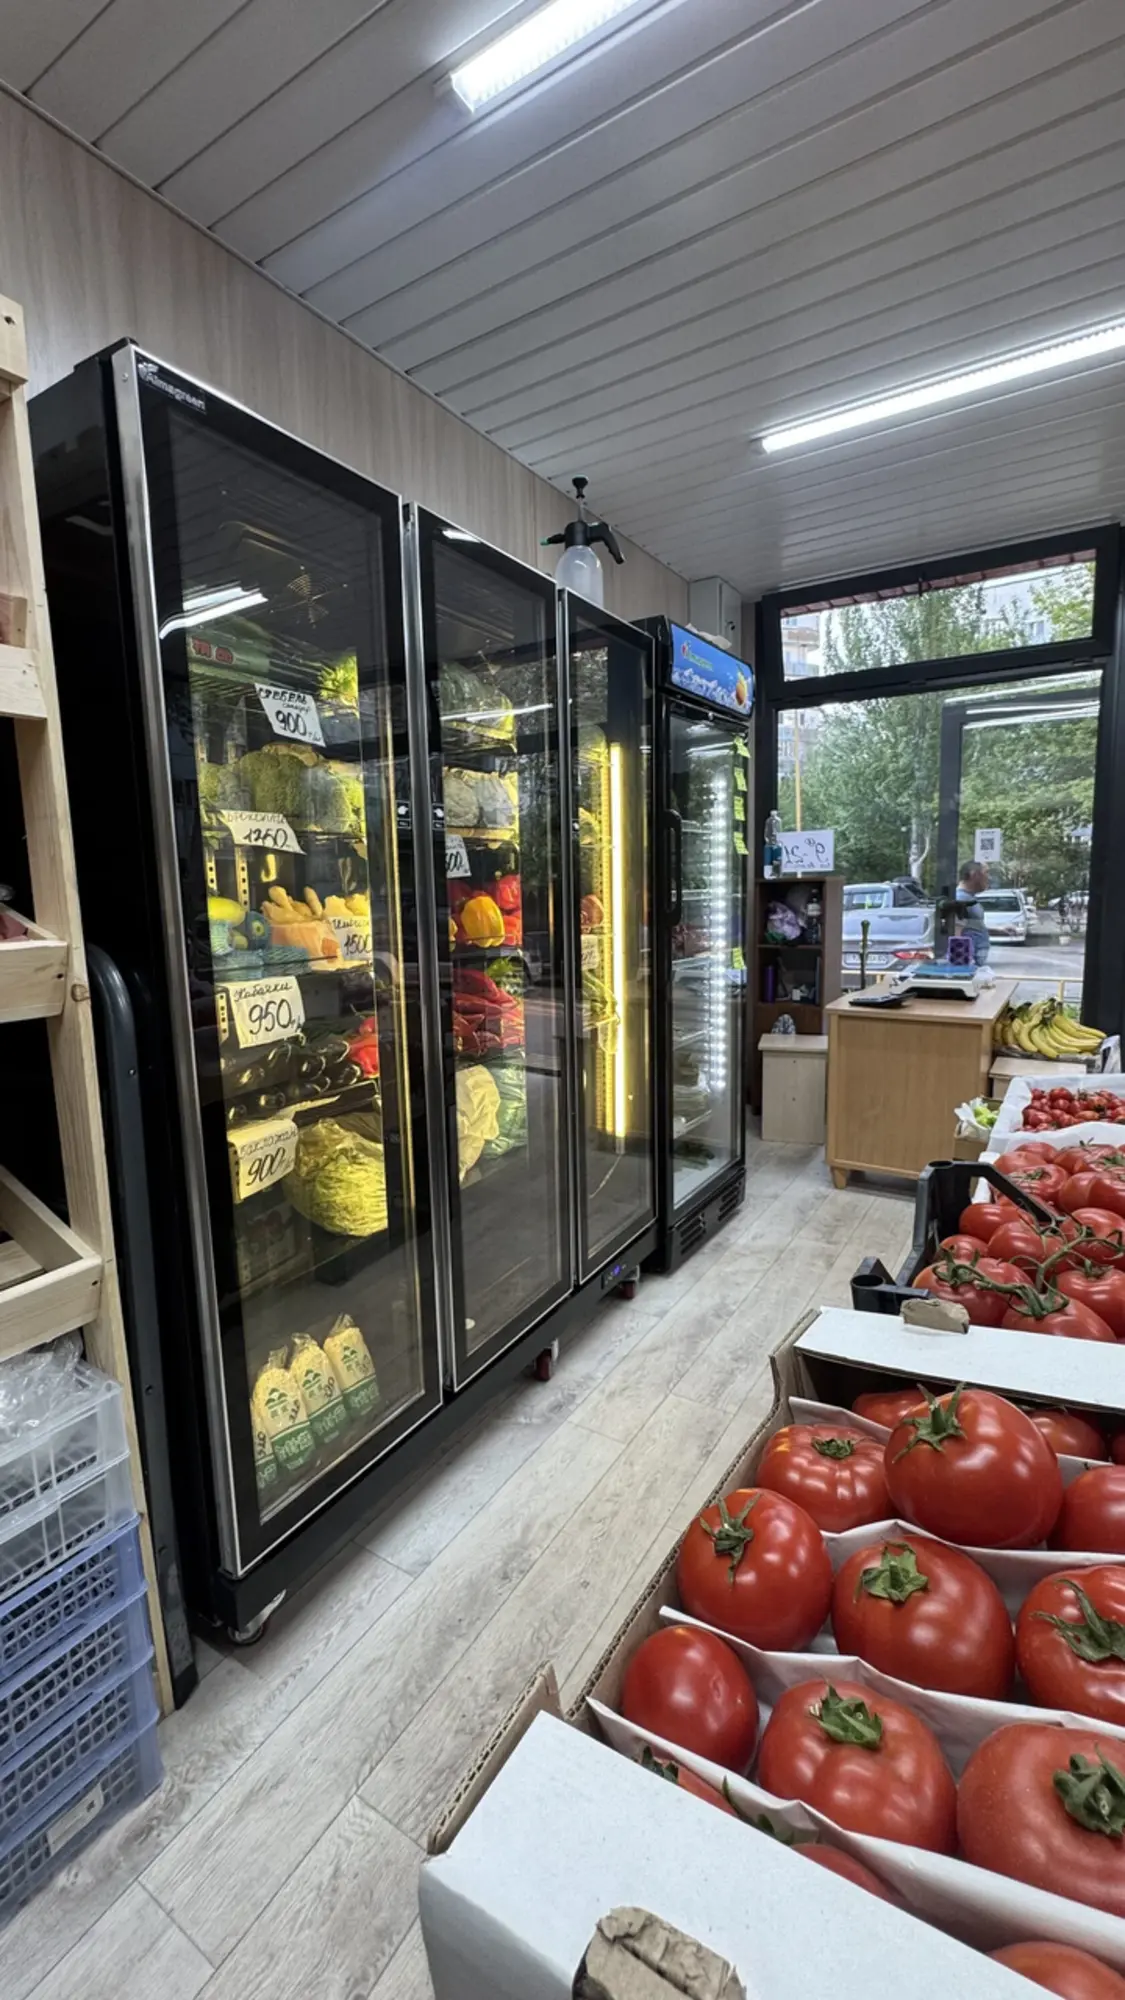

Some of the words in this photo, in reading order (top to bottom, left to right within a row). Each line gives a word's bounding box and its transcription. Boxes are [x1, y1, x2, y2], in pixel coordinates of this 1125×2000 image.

[275, 710, 308, 737] 900
[248, 998, 292, 1035] 950
[246, 1147, 286, 1187] 900
